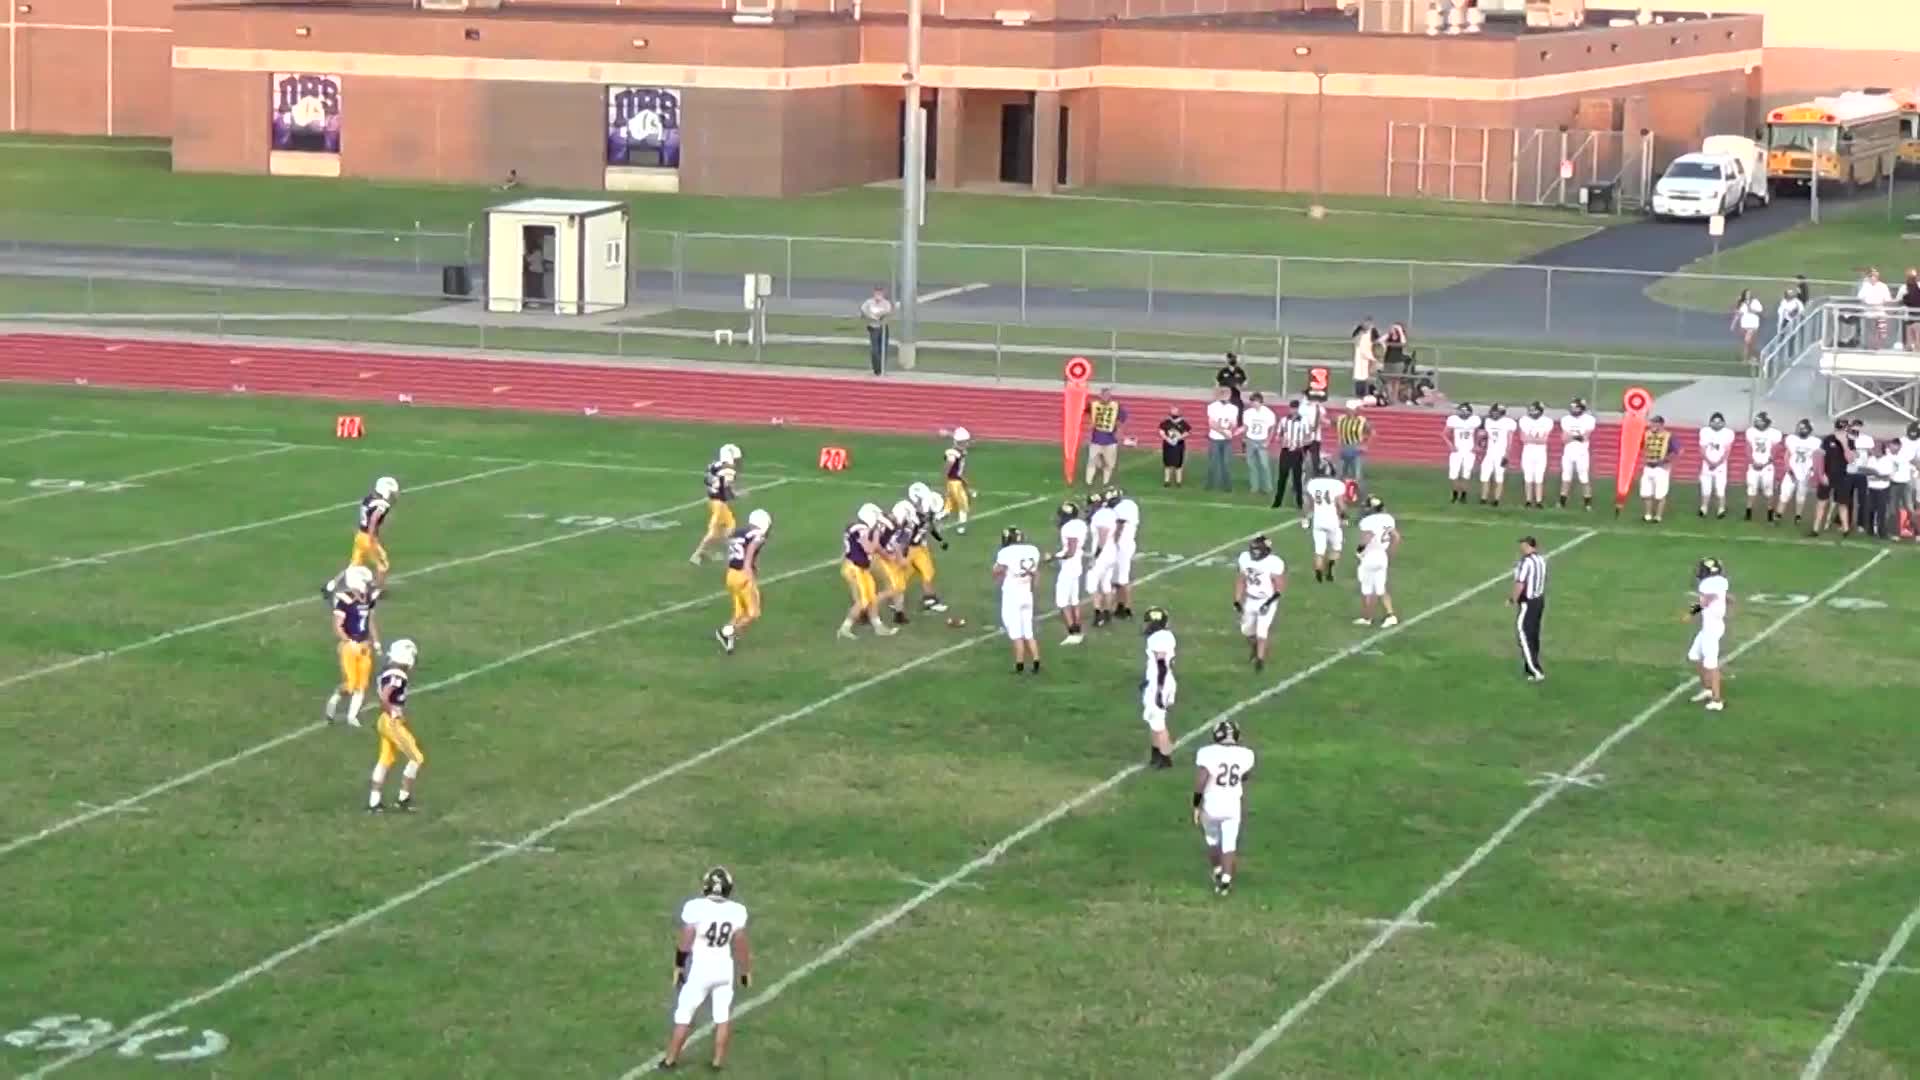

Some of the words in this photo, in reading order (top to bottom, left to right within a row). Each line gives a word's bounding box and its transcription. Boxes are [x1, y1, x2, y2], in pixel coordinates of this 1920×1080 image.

[1310, 368, 1328, 390] 3
[823, 449, 843, 470] 20
[1216, 762, 1240, 787] 26
[704, 921, 732, 948] 48
